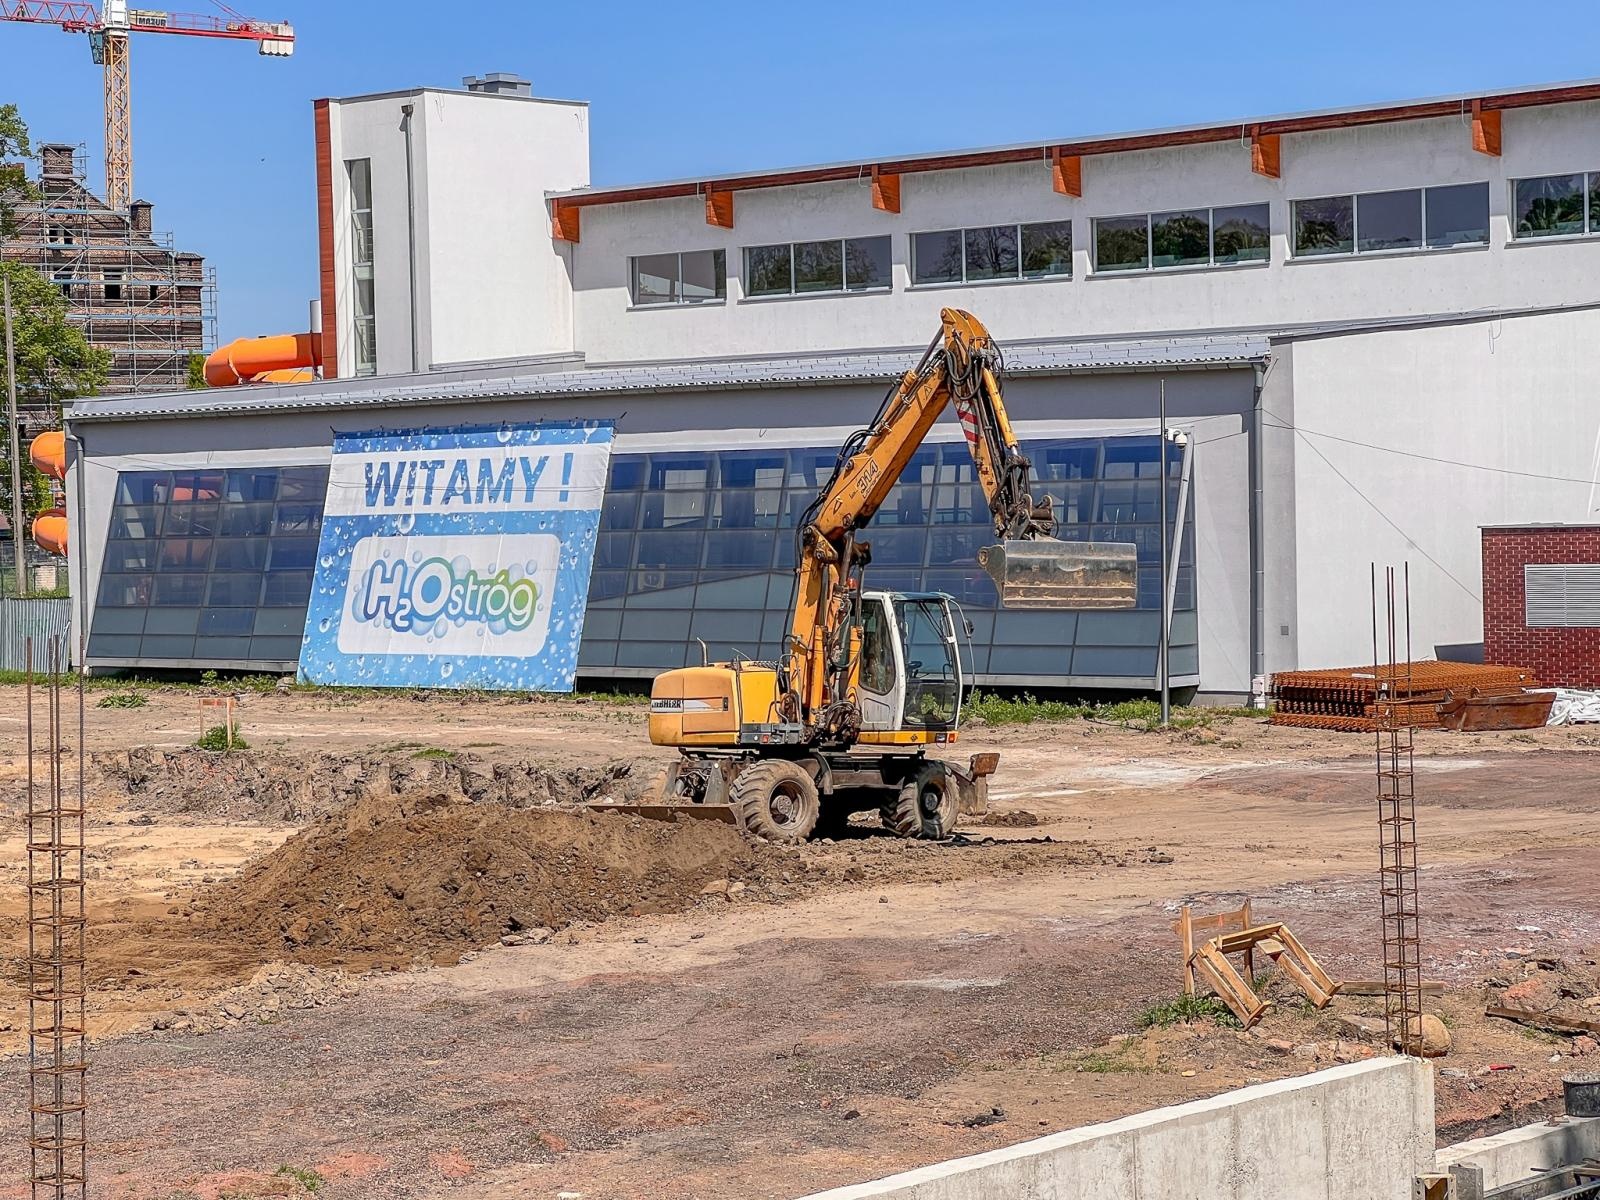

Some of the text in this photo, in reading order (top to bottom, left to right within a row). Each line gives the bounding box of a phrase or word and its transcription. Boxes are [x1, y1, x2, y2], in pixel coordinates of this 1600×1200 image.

[138, 17, 167, 26] MAZUR
[363, 452, 574, 507] WITAMY !
